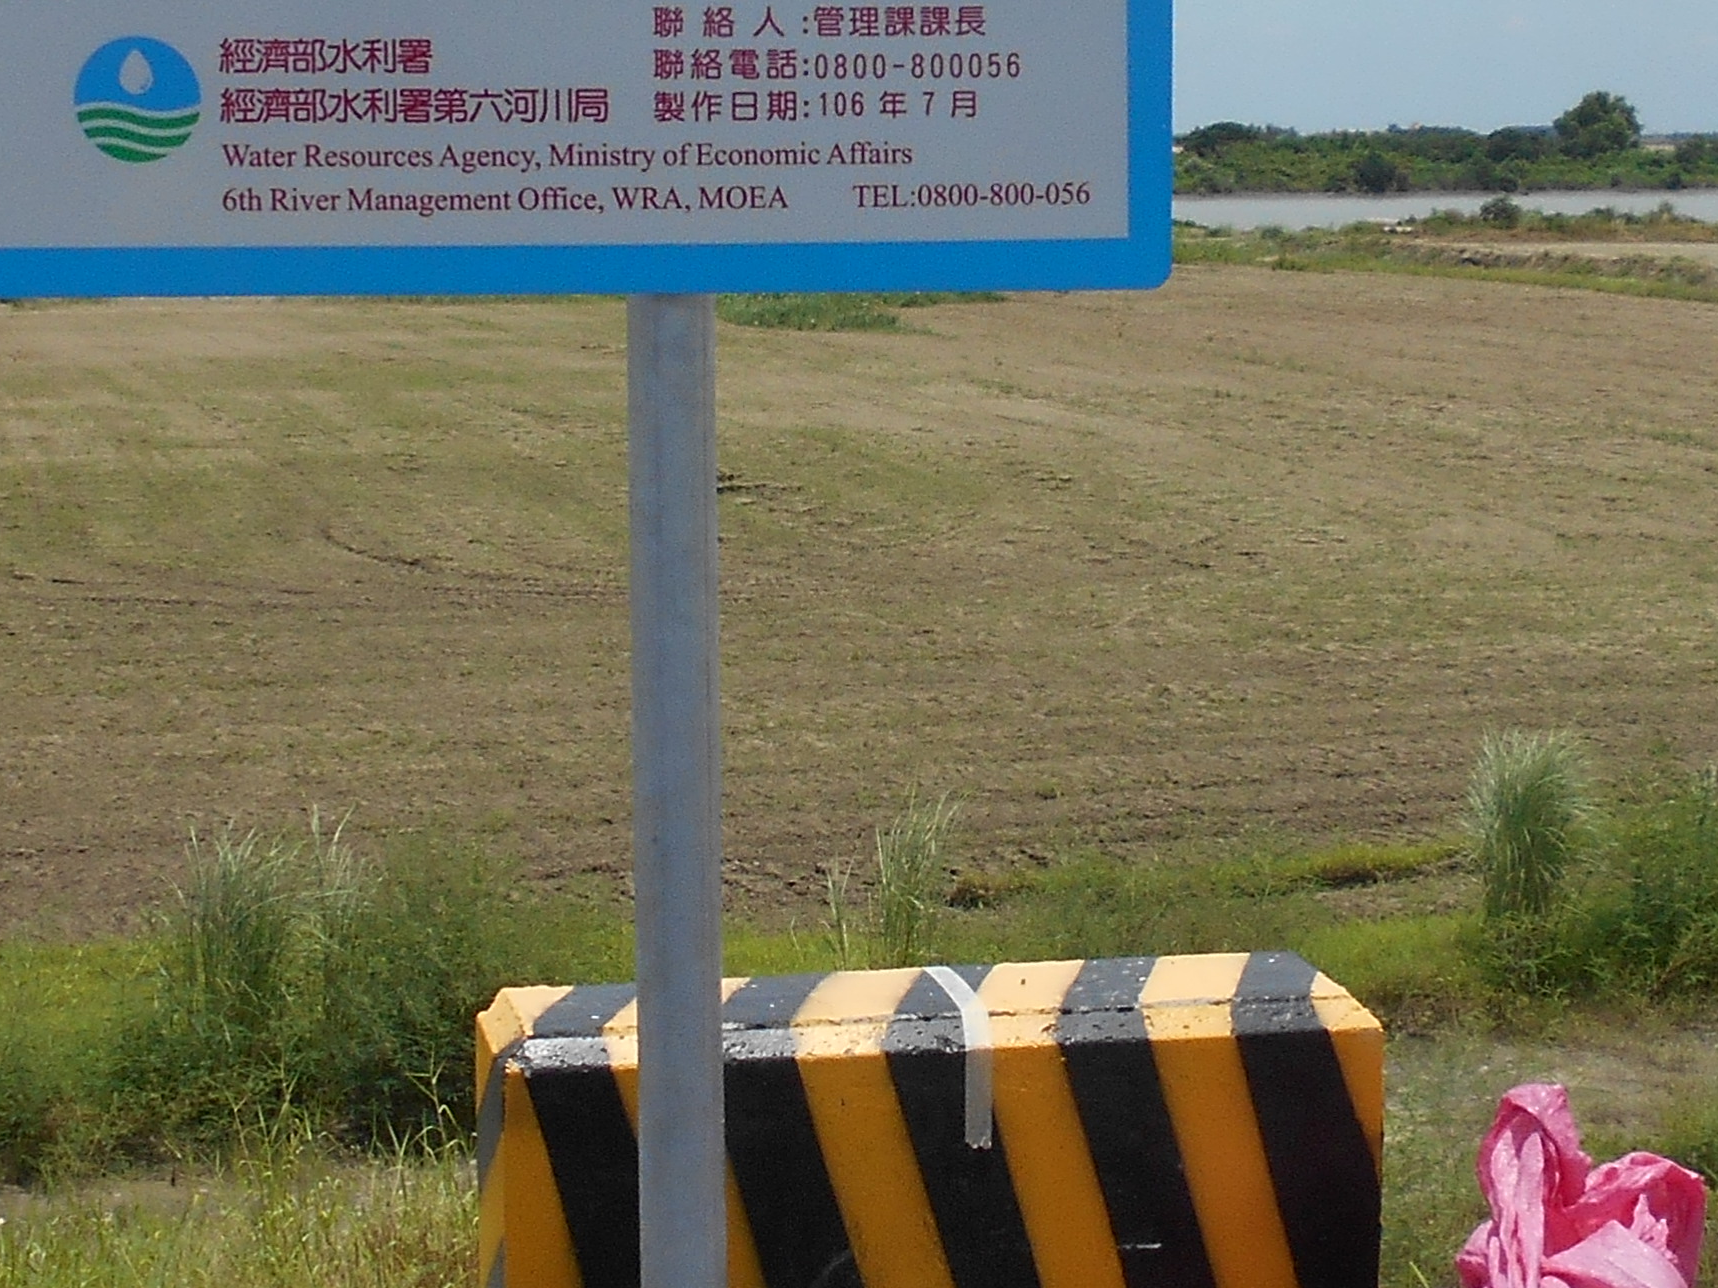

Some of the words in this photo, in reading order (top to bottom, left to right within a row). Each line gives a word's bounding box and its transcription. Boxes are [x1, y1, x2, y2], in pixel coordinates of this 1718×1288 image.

[218, 37, 434, 75] 經濟部水利署
[219, 87, 610, 124] 經濟部水利署第六河川局
[221, 143, 298, 168] Water
[303, 143, 434, 169] Resources
[437, 143, 542, 175] Agency,
[548, 142, 657, 173] Ministry
[662, 141, 693, 167] of
[695, 140, 821, 167] Economic
[825, 140, 913, 166] Affairs
[221, 186, 263, 212] 6th
[268, 187, 342, 212] River
[346, 187, 512, 218] Management
[517, 185, 605, 215] Office,
[610, 185, 692, 214] WRA,
[697, 184, 789, 210] MOEA
[851, 180, 1091, 209] TEL:0800-800-056
